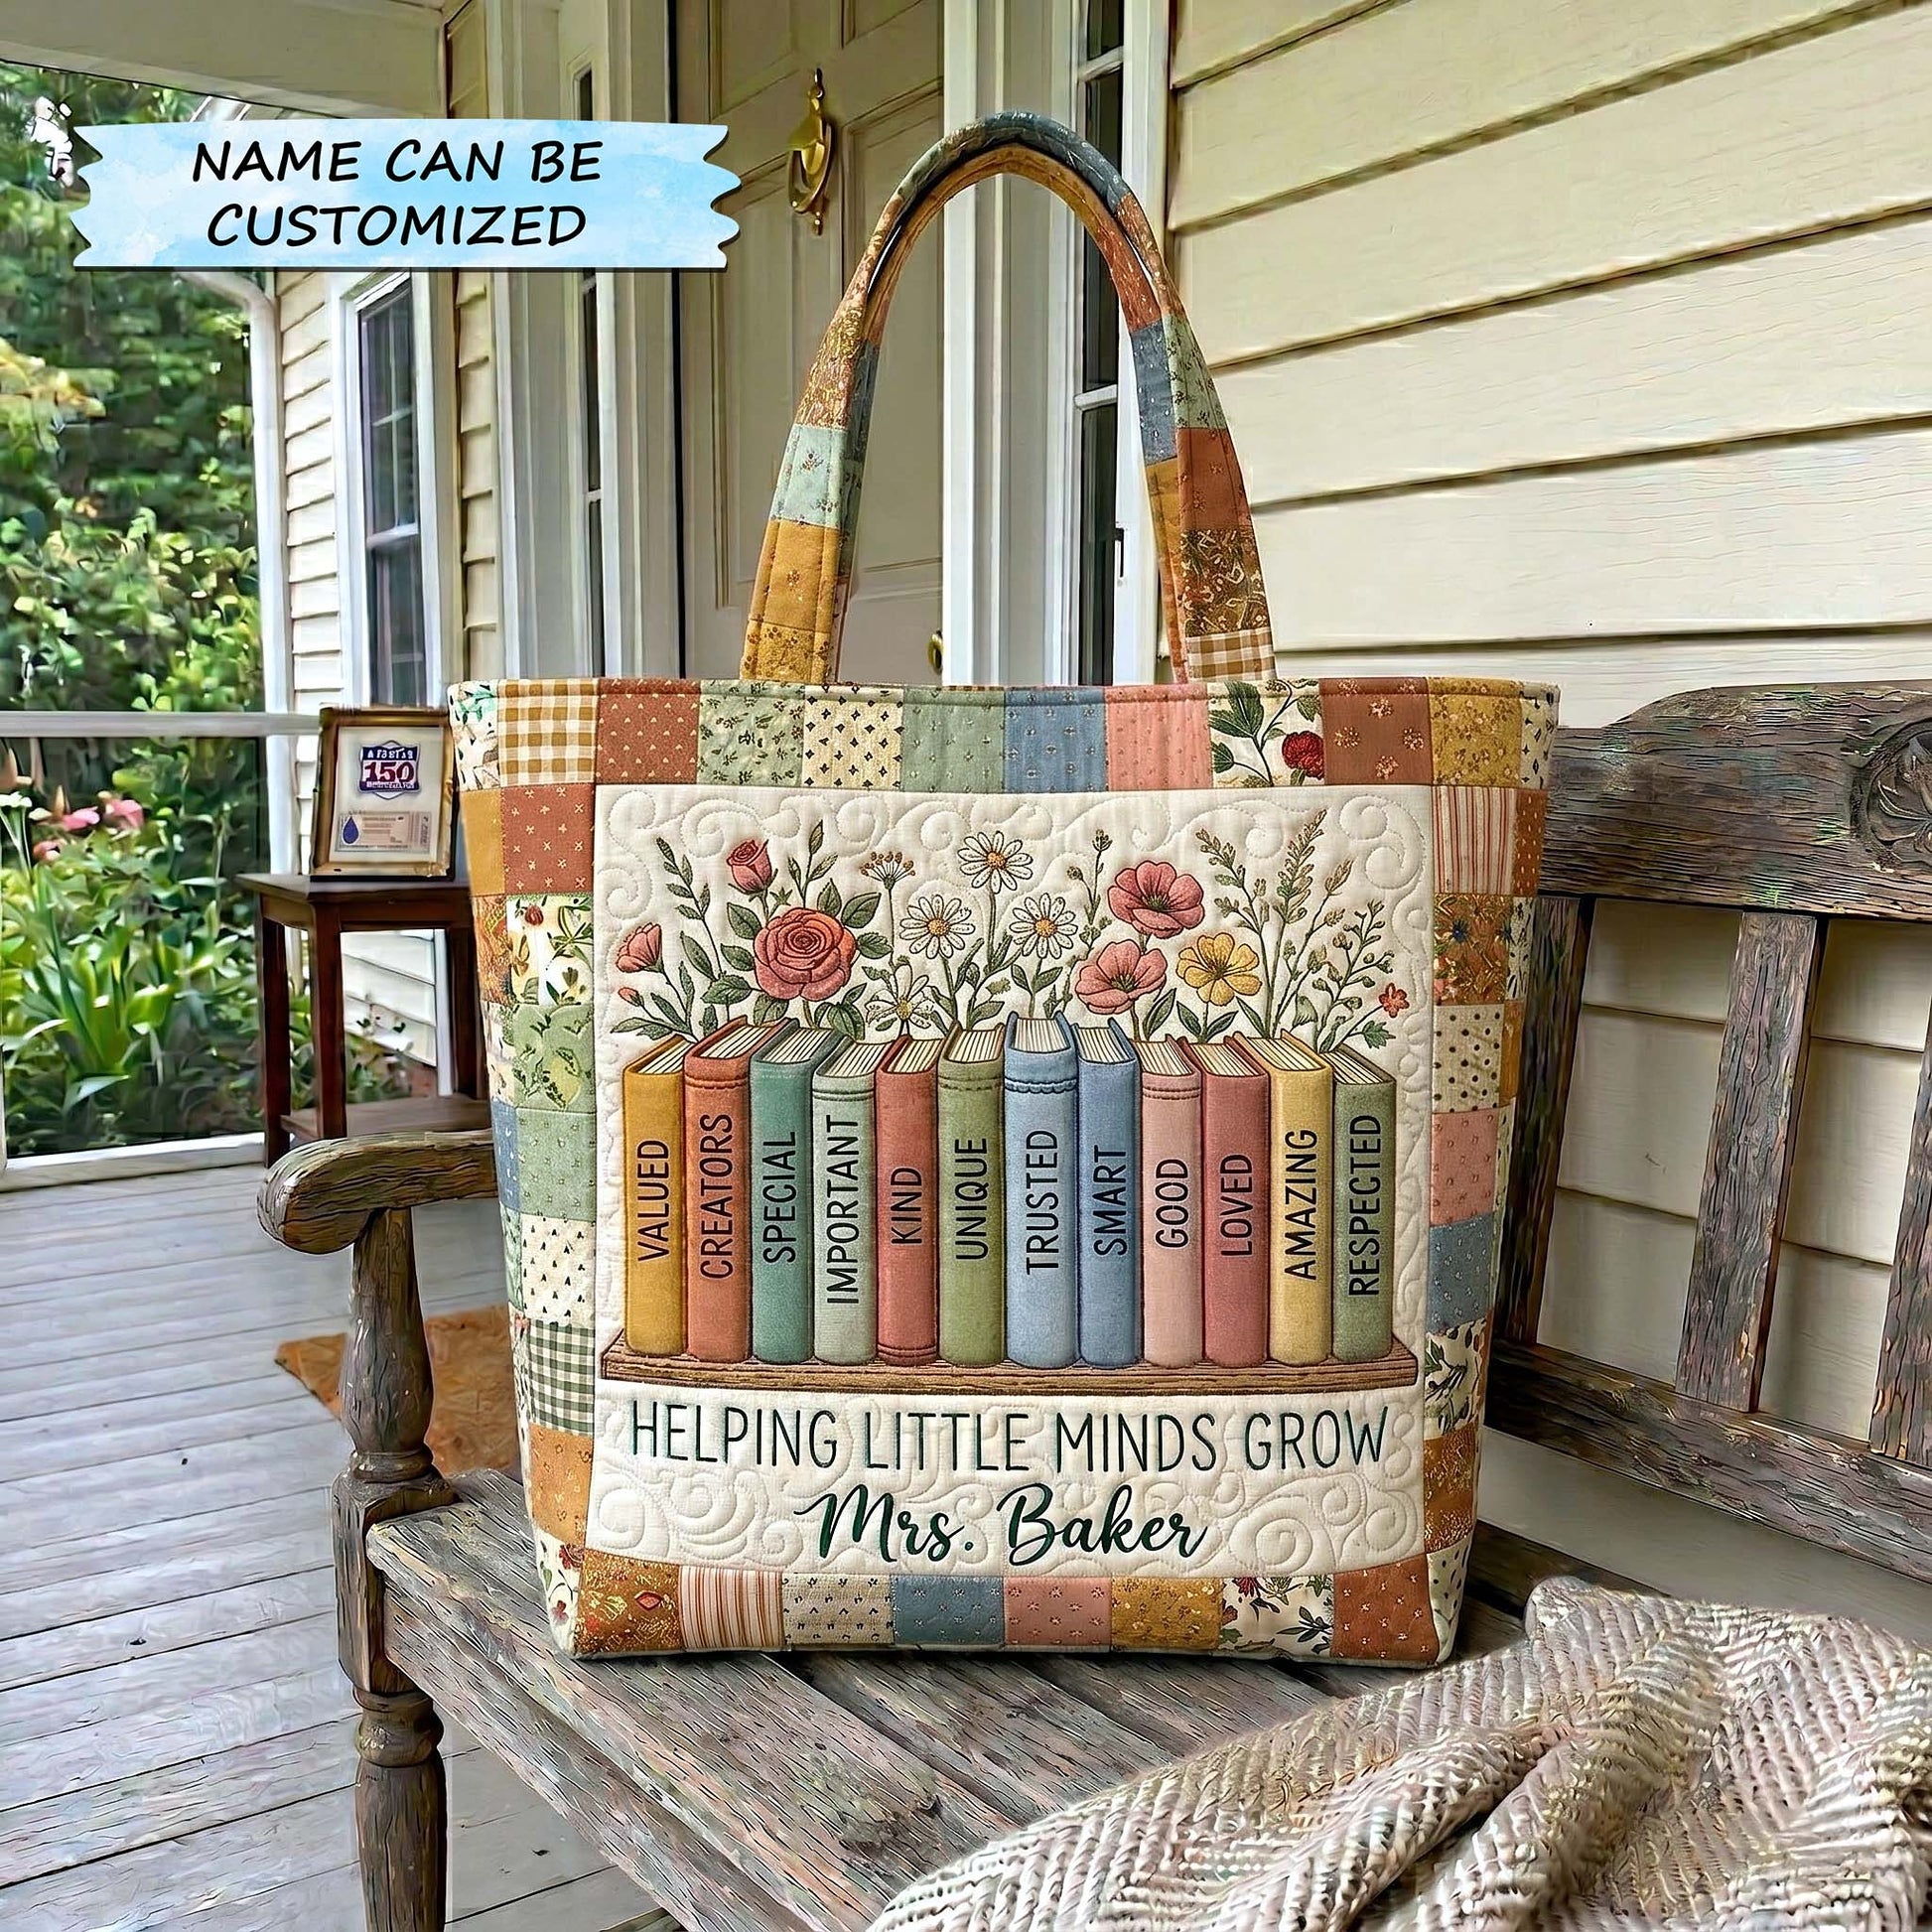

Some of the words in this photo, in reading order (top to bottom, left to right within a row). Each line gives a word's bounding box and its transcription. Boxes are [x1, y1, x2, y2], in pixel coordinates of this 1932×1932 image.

[364, 761, 414, 782] 150
[636, 1140, 670, 1262] VALUED
[699, 1114, 734, 1279] CREATORS
[761, 1131, 797, 1264] SPECIAL
[825, 1114, 860, 1305] IMPORTANT
[890, 1168, 923, 1245] KIND
[954, 1138, 990, 1260] UNIQUE
[1025, 1130, 1059, 1276] TRUSTED
[1091, 1144, 1128, 1256] SMART
[1155, 1159, 1189, 1248] GOOD
[1219, 1154, 1254, 1257] LOVED
[1284, 1129, 1317, 1281] AMAZING
[1347, 1114, 1384, 1297] RESPECTED
[632, 1400, 838, 1468] HELPING
[865, 1411, 1030, 1471] LITTLE
[1055, 1412, 1217, 1474] MINDS
[1244, 1406, 1389, 1471] GROW
[793, 1483, 974, 1563] Mrs.
[996, 1482, 1208, 1567] Baker
